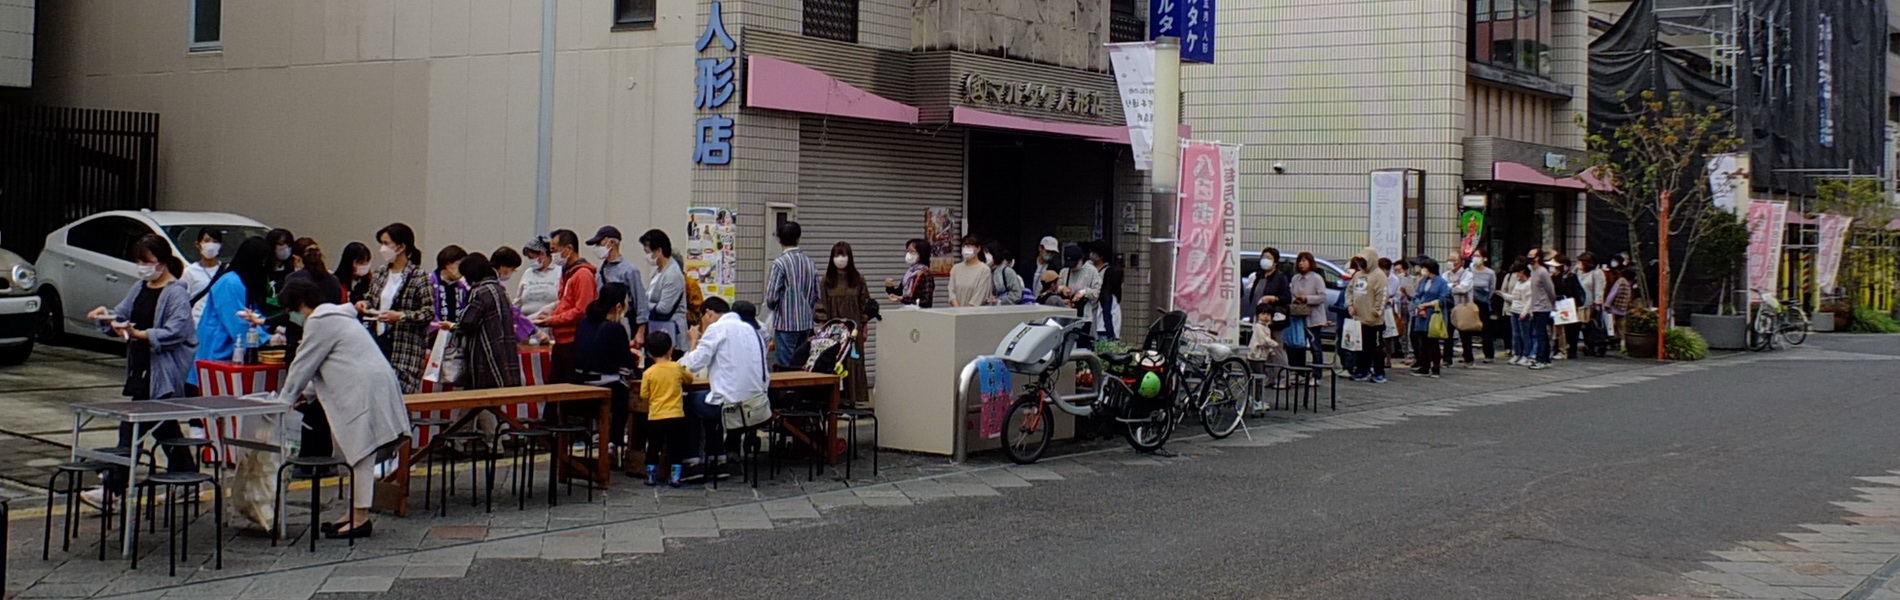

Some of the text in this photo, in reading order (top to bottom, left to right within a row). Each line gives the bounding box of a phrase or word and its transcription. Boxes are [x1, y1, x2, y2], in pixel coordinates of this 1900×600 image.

[1157, 0, 1175, 37] ルタ
[1186, 0, 1199, 52] タケ
[693, 1, 737, 165] 人形店
